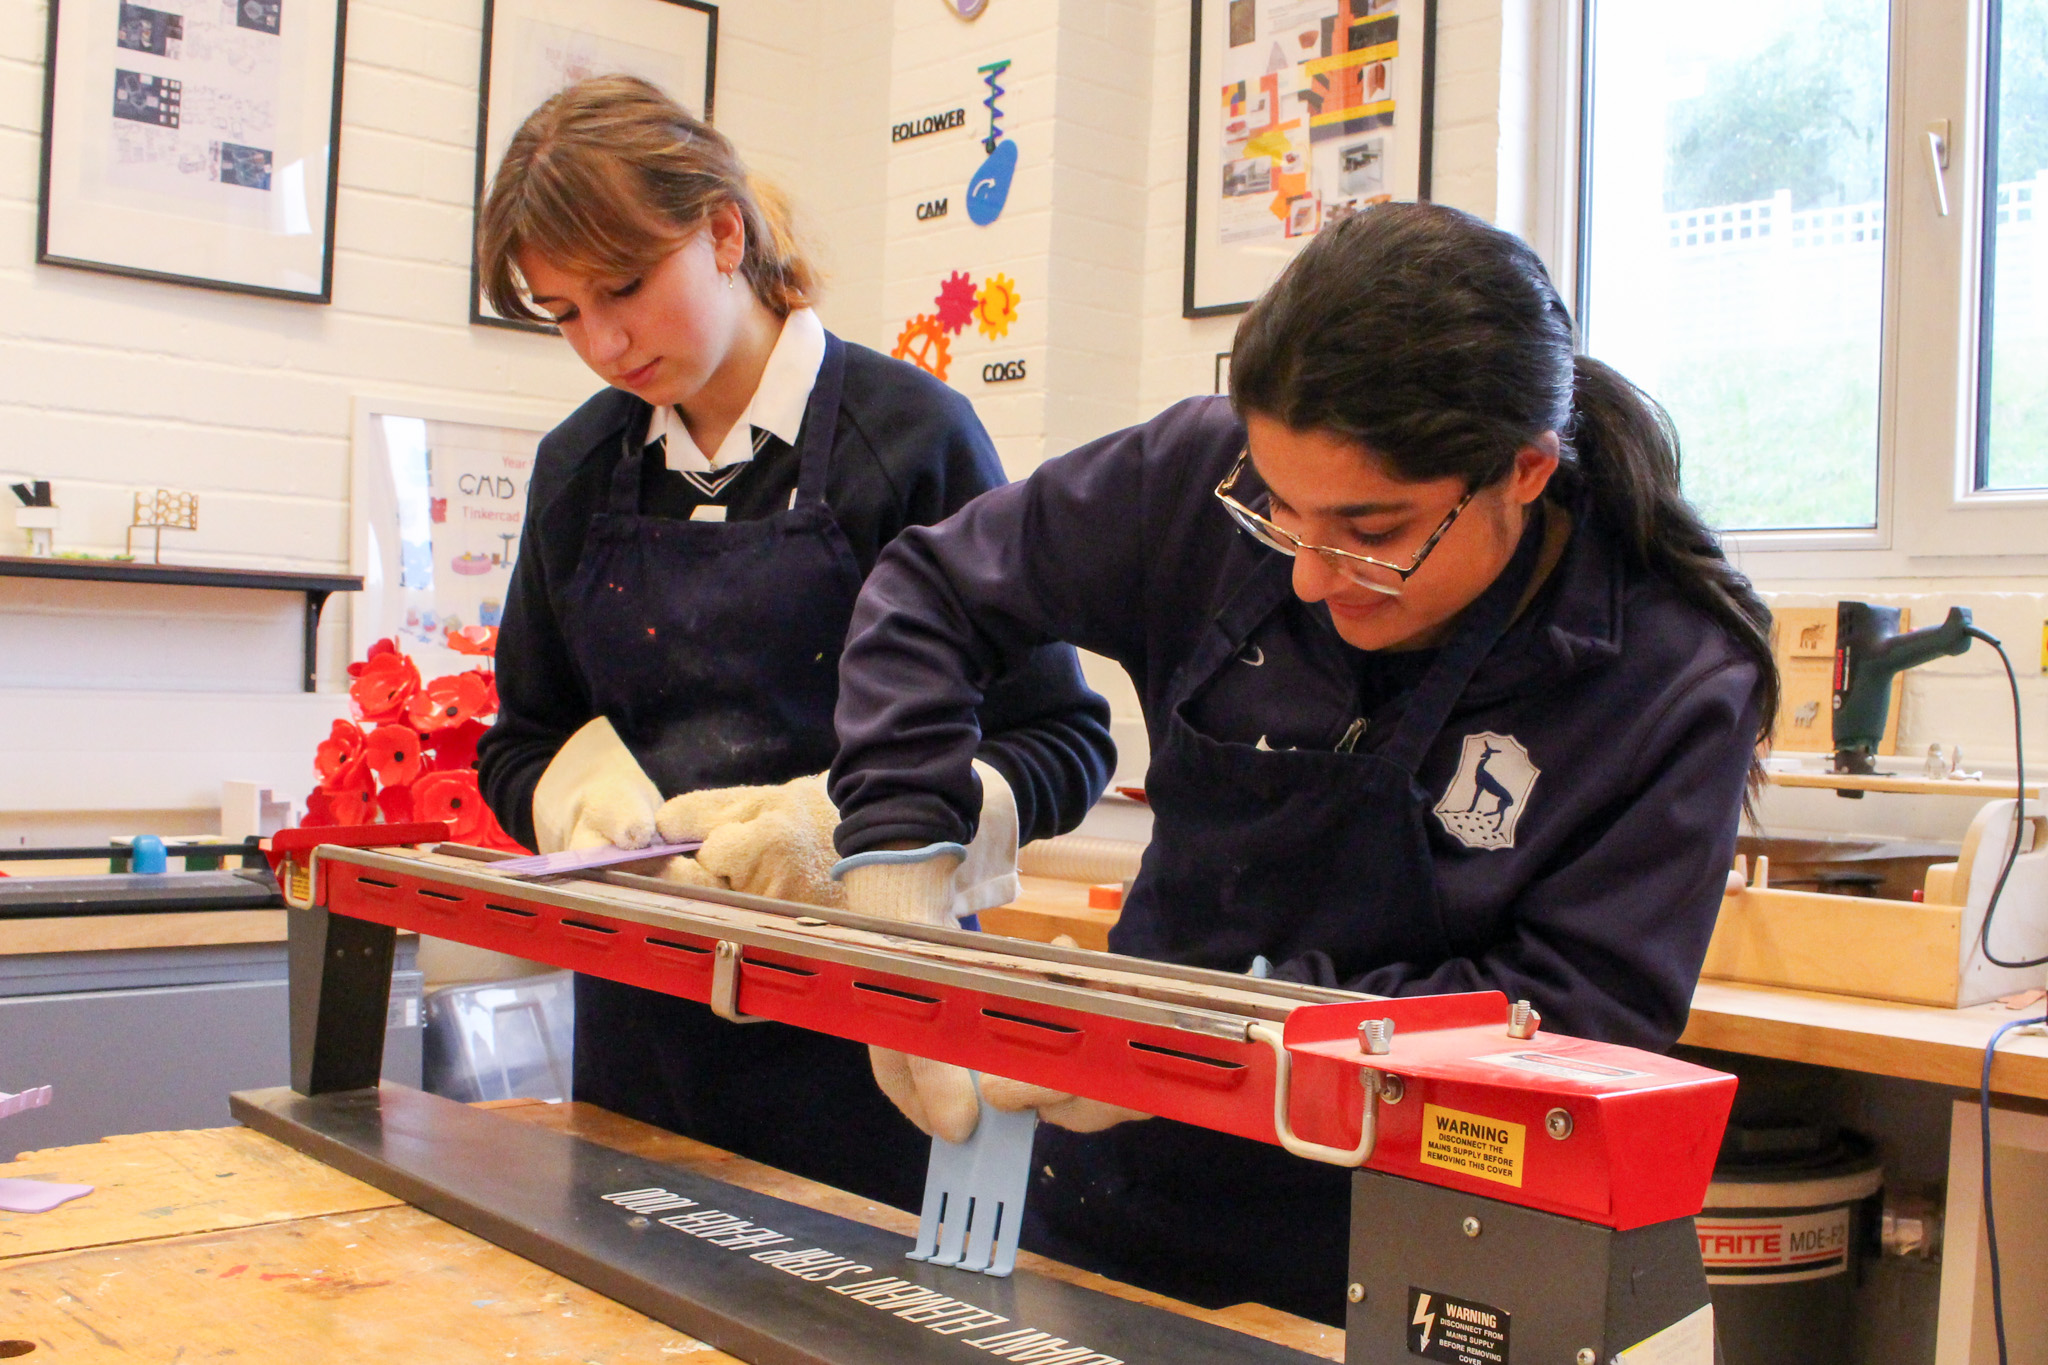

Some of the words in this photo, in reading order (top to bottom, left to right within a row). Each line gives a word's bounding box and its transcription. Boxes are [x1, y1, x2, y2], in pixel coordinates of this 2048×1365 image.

[892, 108, 965, 143] FOLLOWER
[917, 198, 948, 221] CAM
[983, 359, 1026, 382] COGS
[503, 456, 526, 469] Year
[458, 473, 515, 499] CAD
[463, 506, 520, 522] Tinkercad
[1436, 1115, 1509, 1144] WARNING
[1428, 1141, 1451, 1152] MAINS
[1453, 1147, 1481, 1159] SUPPLY
[1484, 1154, 1513, 1167] BEFORE
[1439, 1133, 1487, 1150] DISCONNECT
[1489, 1144, 1503, 1154] THE
[1427, 1151, 1466, 1166] REMOVING
[1469, 1160, 1485, 1171] THIS
[1487, 1165, 1513, 1177] COVER
[601, 1187, 699, 1215] 1000
[658, 1210, 794, 1250] HEATER
[1698, 1234, 1781, 1254] TRITE
[749, 1247, 873, 1281] STRIP
[826, 1277, 1010, 1335] ELEMENT
[1446, 1303, 1497, 1328] WARNING
[1440, 1318, 1482, 1335] DISCONNECT
[1483, 1329, 1503, 1341] FROM
[1446, 1330, 1467, 1342] MAINS
[1469, 1336, 1494, 1349] SUPPLY
[1439, 1339, 1465, 1352] BEFORE
[1466, 1346, 1502, 1362] REMOVING
[1459, 1354, 1482, 1365] COVER
